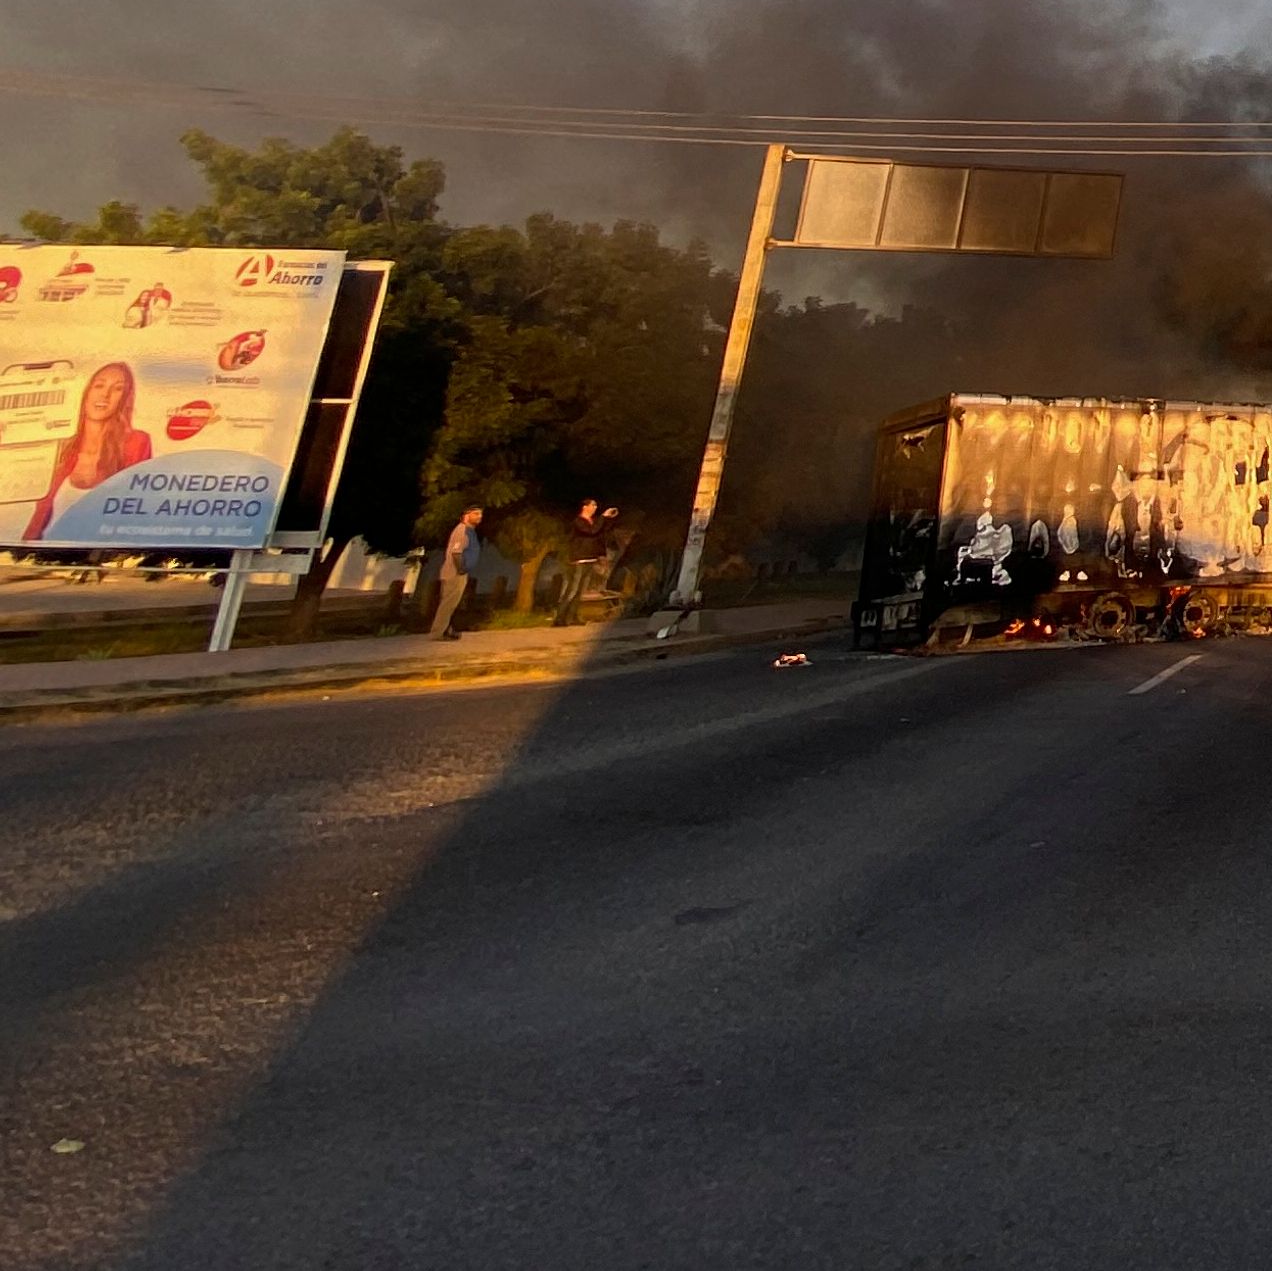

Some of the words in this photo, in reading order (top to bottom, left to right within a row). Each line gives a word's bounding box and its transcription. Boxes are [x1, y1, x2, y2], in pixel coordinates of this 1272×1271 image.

[268, 271, 324, 285] Ahorro
[130, 474, 269, 492] MONEDERO
[103, 498, 146, 515] DEL
[155, 499, 262, 517] AHORRO
